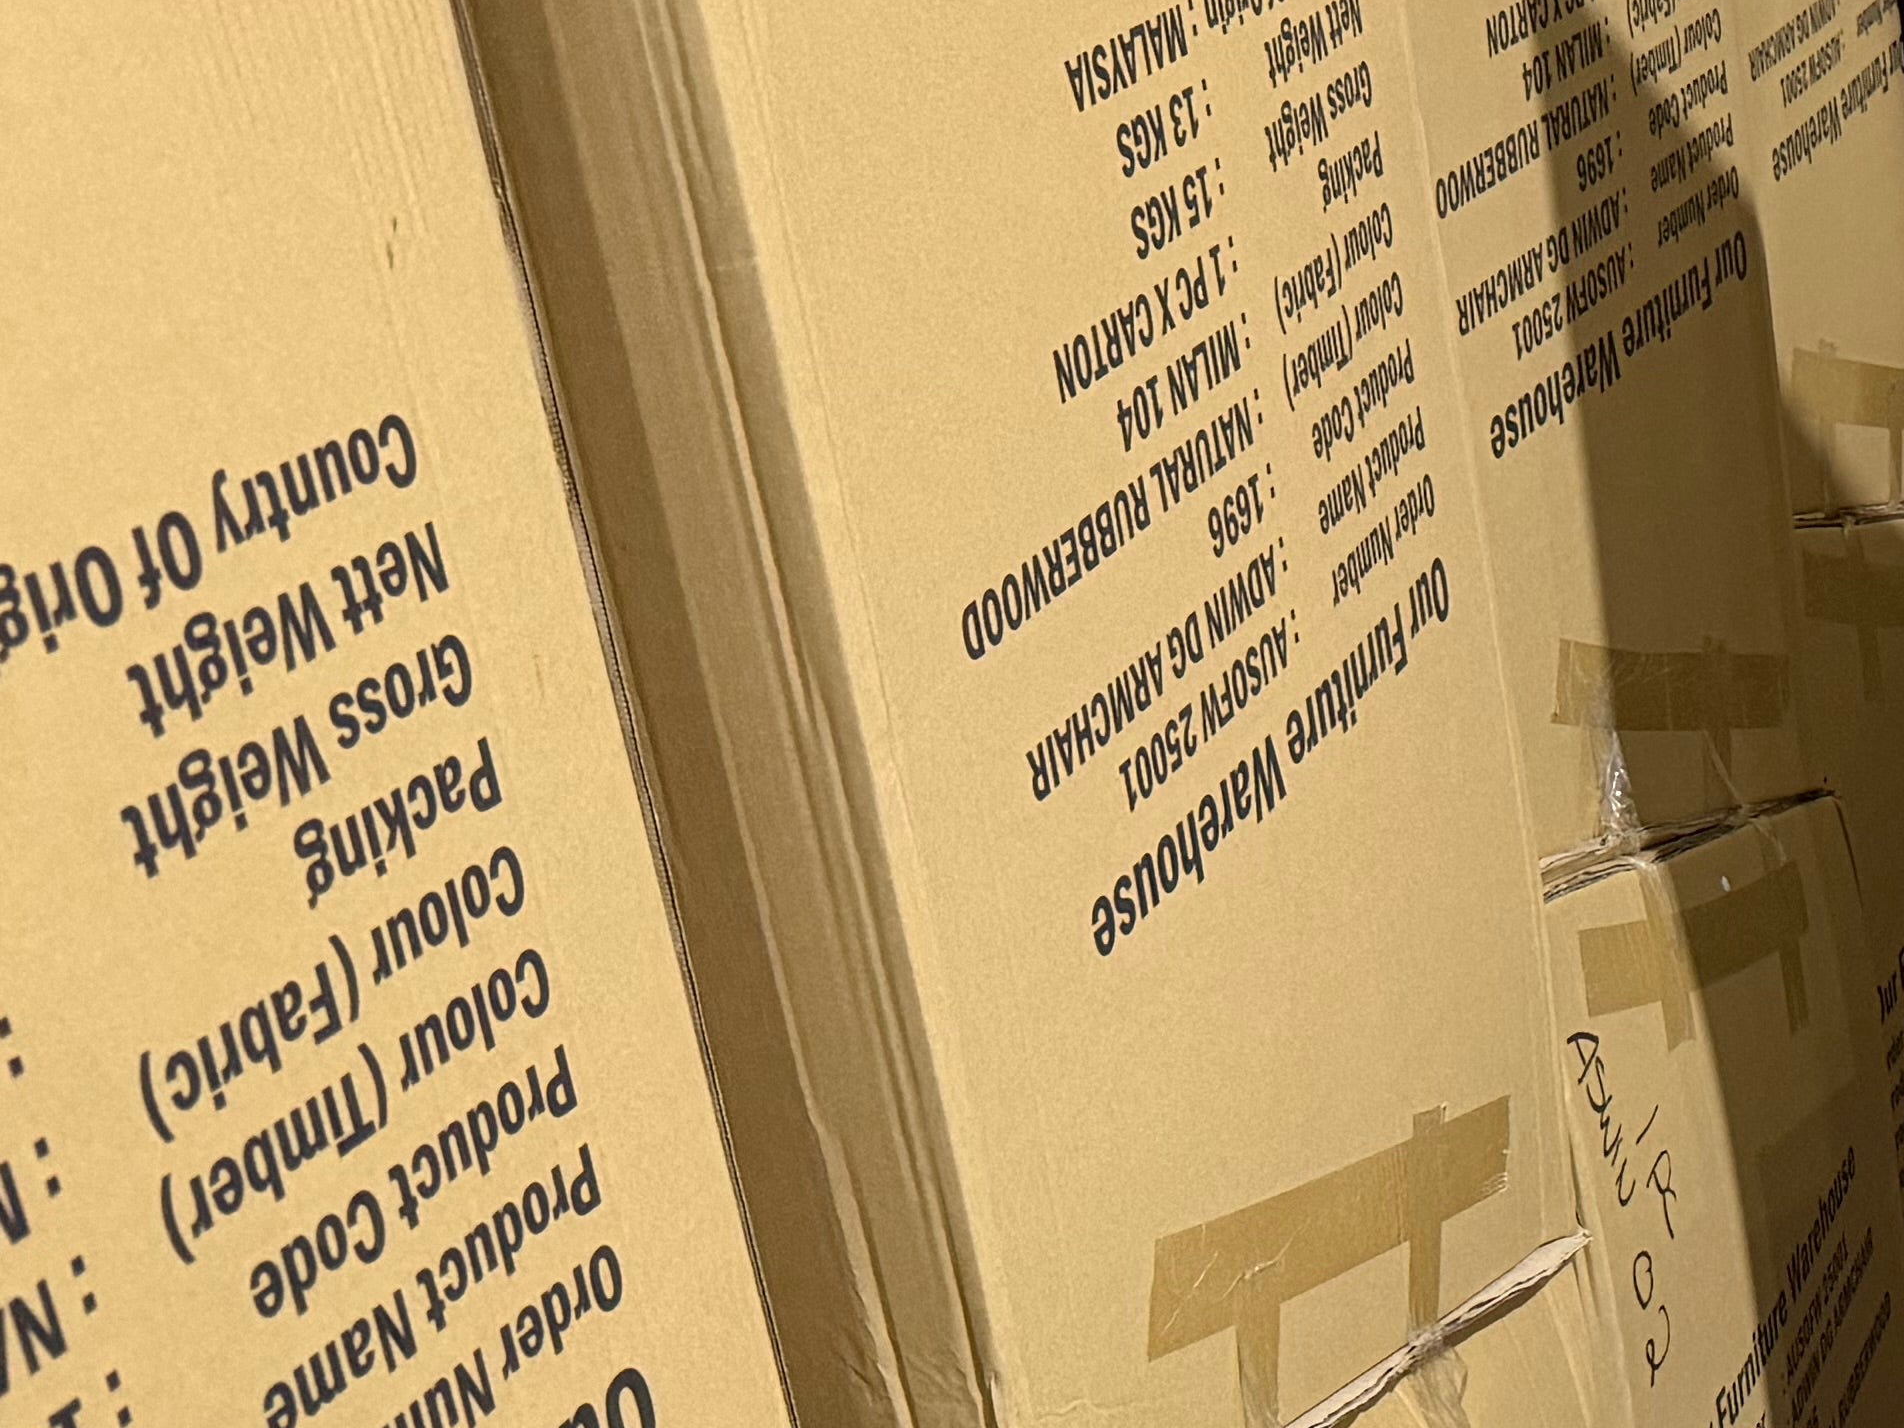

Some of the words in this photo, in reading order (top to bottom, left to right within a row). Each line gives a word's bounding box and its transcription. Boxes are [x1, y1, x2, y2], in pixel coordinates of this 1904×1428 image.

[1062, 2, 1189, 113] MALAYSIA
[1325, 59, 1373, 121] Gross
[1678, 58, 1729, 121] Product
[1262, 90, 1329, 173] Weight
[1574, 134, 1615, 193] 1696
[1646, 91, 1680, 141] Code
[1129, 183, 1182, 260] KGS
[1181, 163, 1213, 229] 15
[1342, 200, 1393, 272] Colour
[1272, 231, 1342, 336] (Fabric)
[1352, 270, 1404, 342] Colour
[1620, 254, 1713, 358] Furniture
[1713, 228, 1748, 288] Our
[1164, 318, 1242, 416] MILAN
[1281, 302, 1353, 412] (Timber)
[1488, 328, 1622, 460] Warehouse
[1115, 373, 1164, 453] 104
[1147, 395, 1254, 513] NATURAL
[1362, 404, 1426, 499] Product
[209, 412, 417, 554] Country
[1316, 462, 1367, 535] Name
[1392, 472, 1435, 542] Order
[129, 509, 203, 610] Of
[328, 519, 449, 636] Nett
[960, 473, 1151, 661] RUBBERWOOD
[1202, 542, 1276, 650] ADWIN
[1330, 513, 1395, 608] Number
[1407, 555, 1449, 640] Our
[123, 580, 337, 739] Weight
[326, 633, 472, 750] Gross
[1164, 609, 1204, 679] DG
[1198, 615, 1288, 744] AUSOFW
[1284, 600, 1409, 765] Furniture
[1024, 639, 1164, 802] ARMCHAIR
[1117, 701, 1198, 813] 25001
[118, 713, 331, 879] Weight
[291, 734, 502, 910] Packing
[1090, 732, 1287, 957] Warehouse
[368, 844, 525, 986] Colour
[137, 932, 360, 1144] (Fabric)
[397, 947, 550, 1092] Colour
[158, 1041, 388, 1265] (Timber)
[386, 1042, 578, 1231] Product
[248, 1188, 386, 1318] Code
[413, 1141, 601, 1333] Product
[498, 1243, 623, 1381] Order
